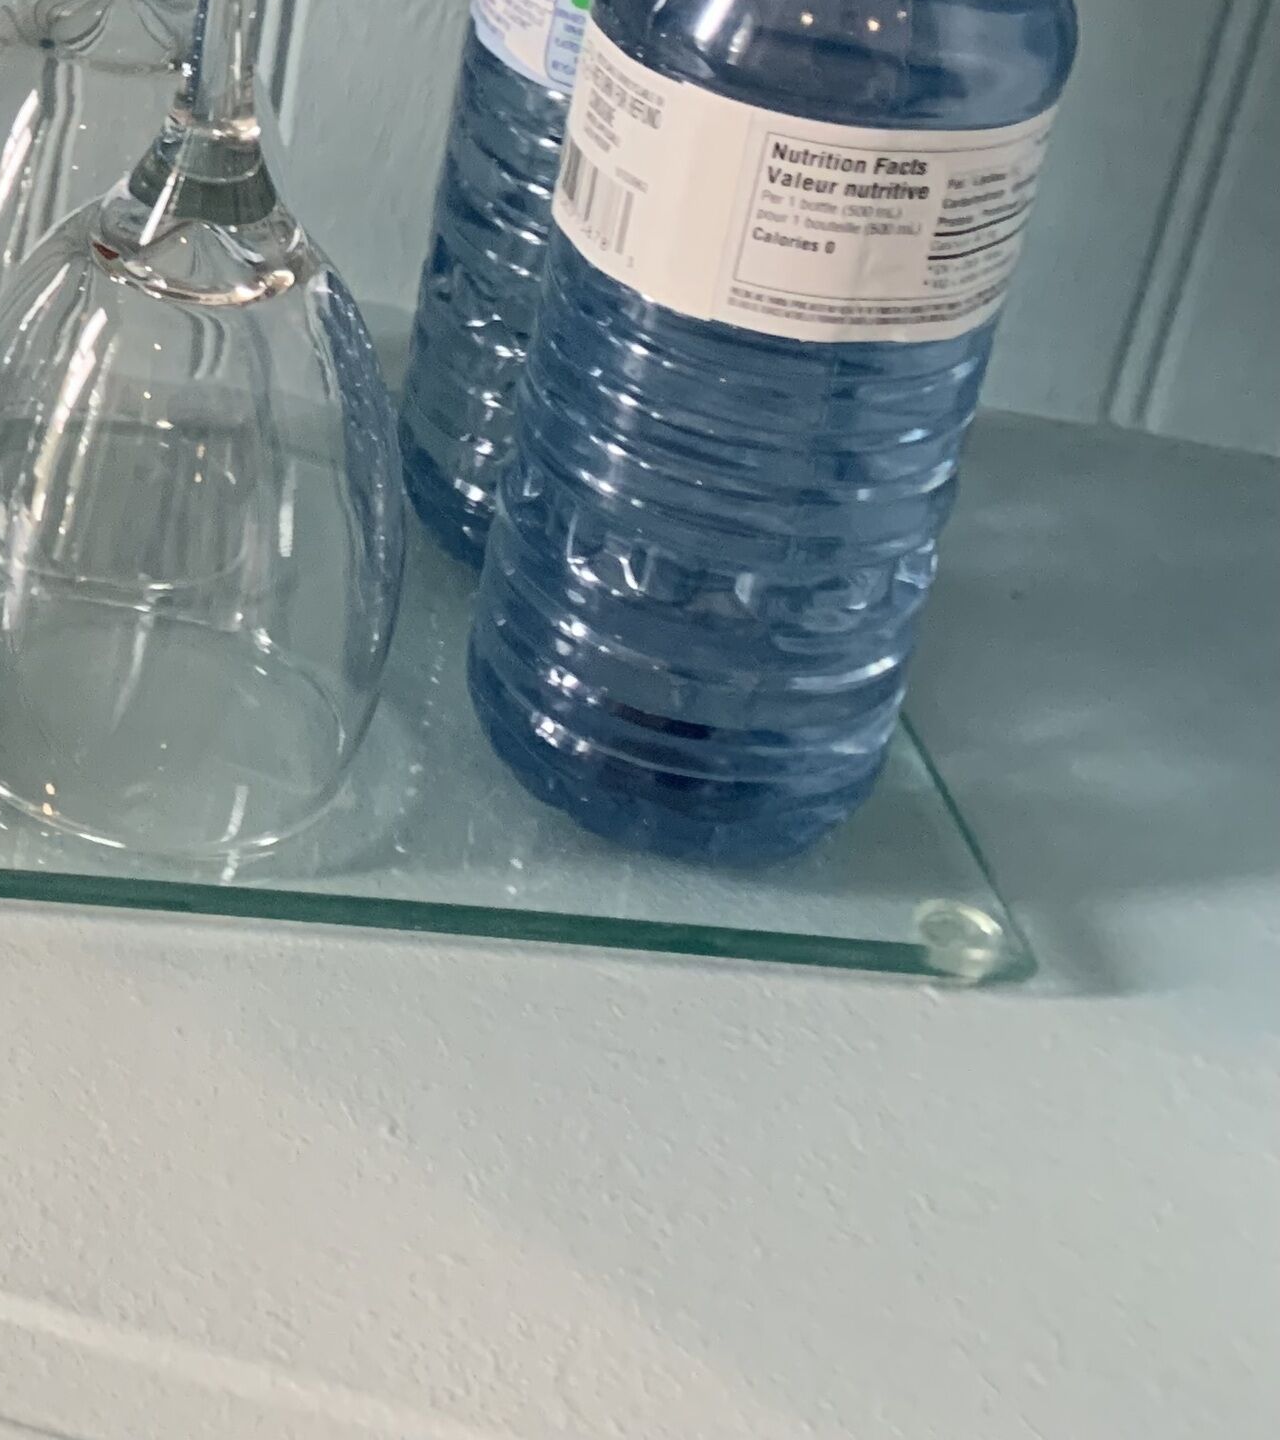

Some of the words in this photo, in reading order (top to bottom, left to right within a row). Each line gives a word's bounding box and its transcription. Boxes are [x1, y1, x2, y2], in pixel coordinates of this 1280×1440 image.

[772, 142, 866, 174] Nutrition
[873, 157, 928, 176] Facts
[767, 165, 840, 195] Valeur
[844, 180, 930, 200] nutritive
[752, 226, 819, 253] Calories
